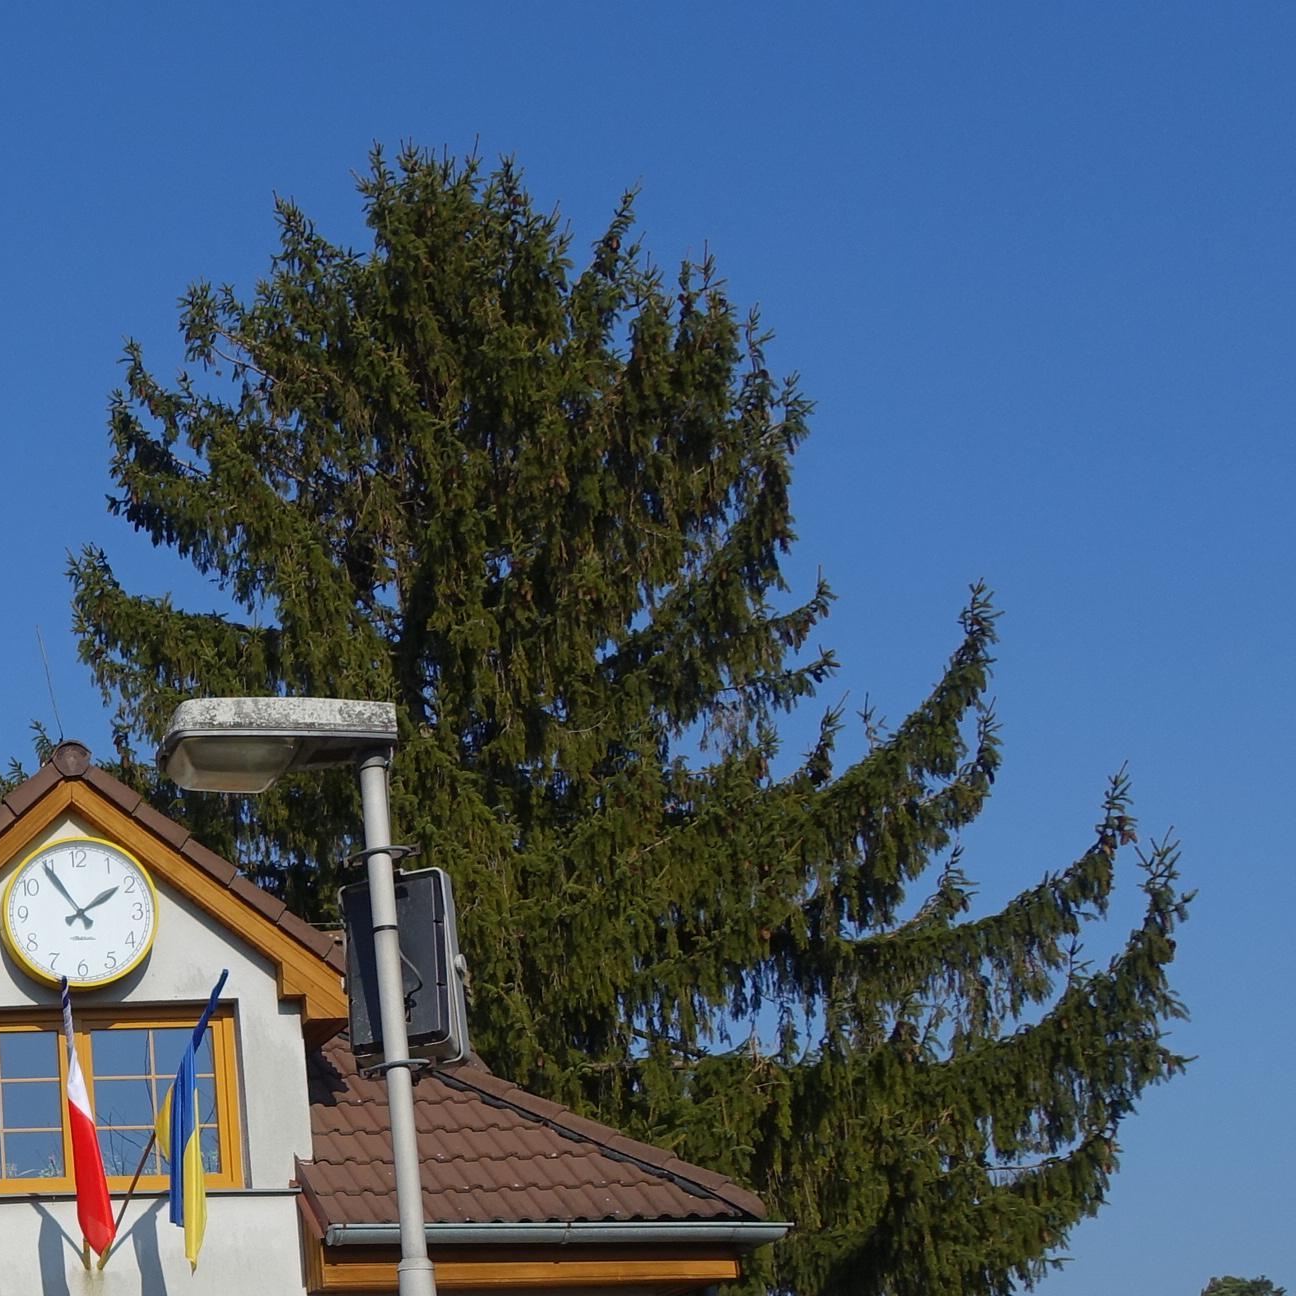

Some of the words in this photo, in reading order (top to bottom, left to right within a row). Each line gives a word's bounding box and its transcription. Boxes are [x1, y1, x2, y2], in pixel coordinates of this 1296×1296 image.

[69, 850, 87, 868] 12
[104, 857, 111, 875] 1
[20, 878, 40, 897] 10
[123, 875, 135, 894] 2
[17, 905, 29, 923] 9
[131, 902, 144, 921] 3
[26, 932, 39, 952] 8
[124, 930, 136, 948] 4
[48, 952, 60, 971] 7
[77, 959, 89, 977] 6
[104, 951, 117, 969] 5
